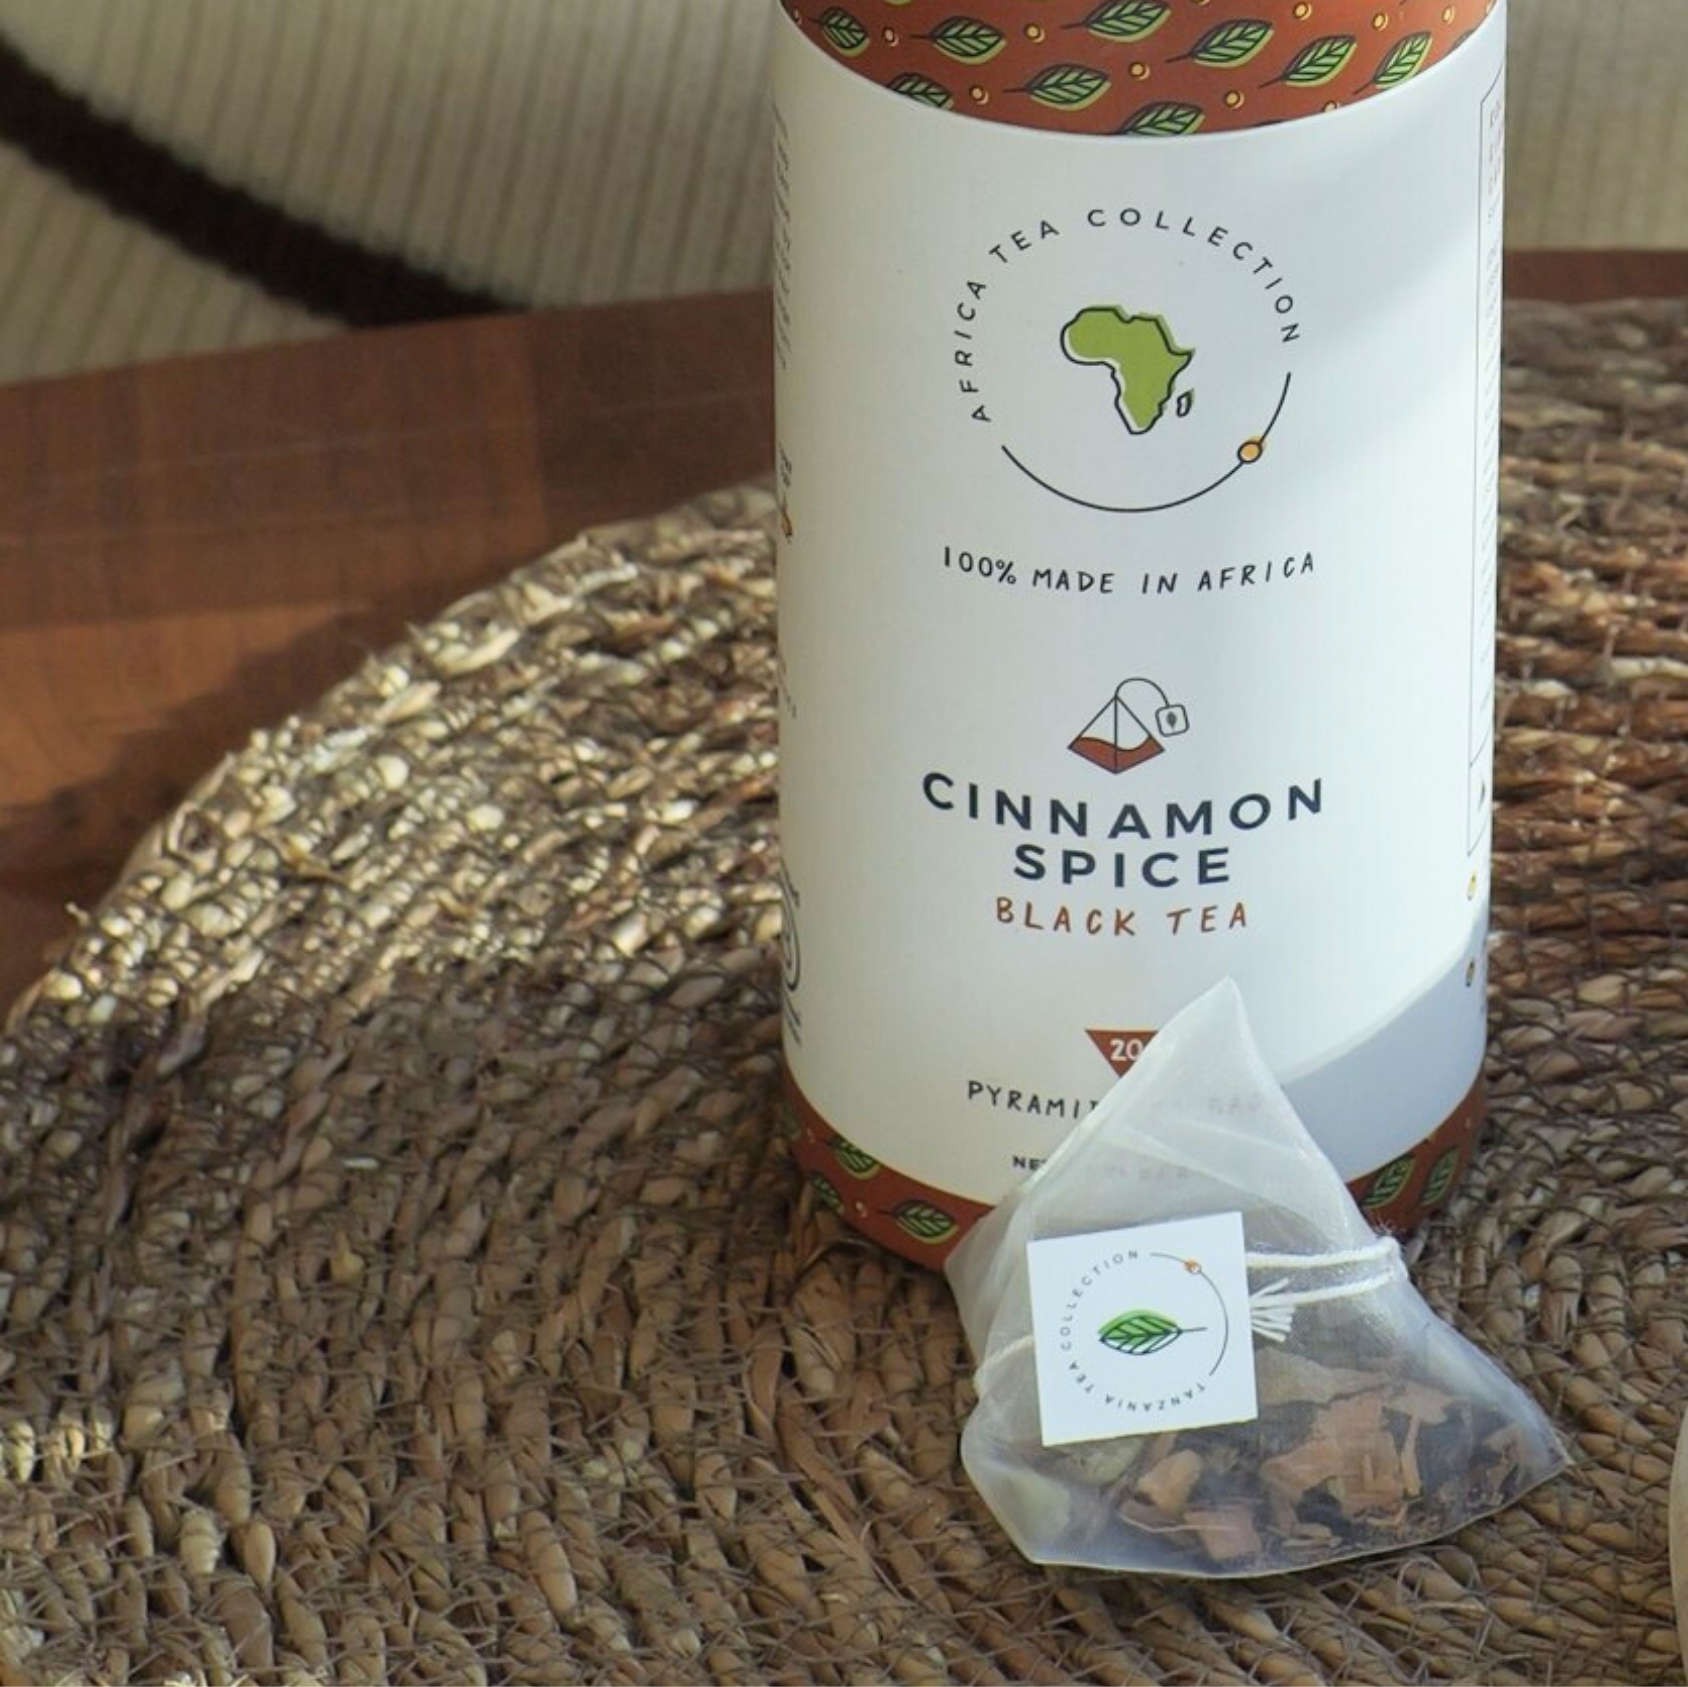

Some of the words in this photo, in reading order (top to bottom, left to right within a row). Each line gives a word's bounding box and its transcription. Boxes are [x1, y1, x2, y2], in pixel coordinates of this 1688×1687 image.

[954, 280, 992, 423] AFRICA
[989, 220, 1059, 264] TEA
[1087, 208, 1301, 343] COLLECTION
[944, 546, 1017, 585] 100%
[1032, 568, 1115, 594] MADE
[1141, 572, 1179, 595] IN
[1198, 551, 1315, 593] AFRICA
[922, 772, 1322, 840] CINNAMON
[1013, 843, 1230, 889] SPICE
[996, 896, 1137, 936] BLACK
[1166, 902, 1248, 936] TEA
[1109, 1038, 1144, 1062] 20
[1060, 1249, 1139, 1351] COLLECTION
[1068, 1361, 1095, 1394] TEA
[1105, 1382, 1206, 1412] TANZANIA
